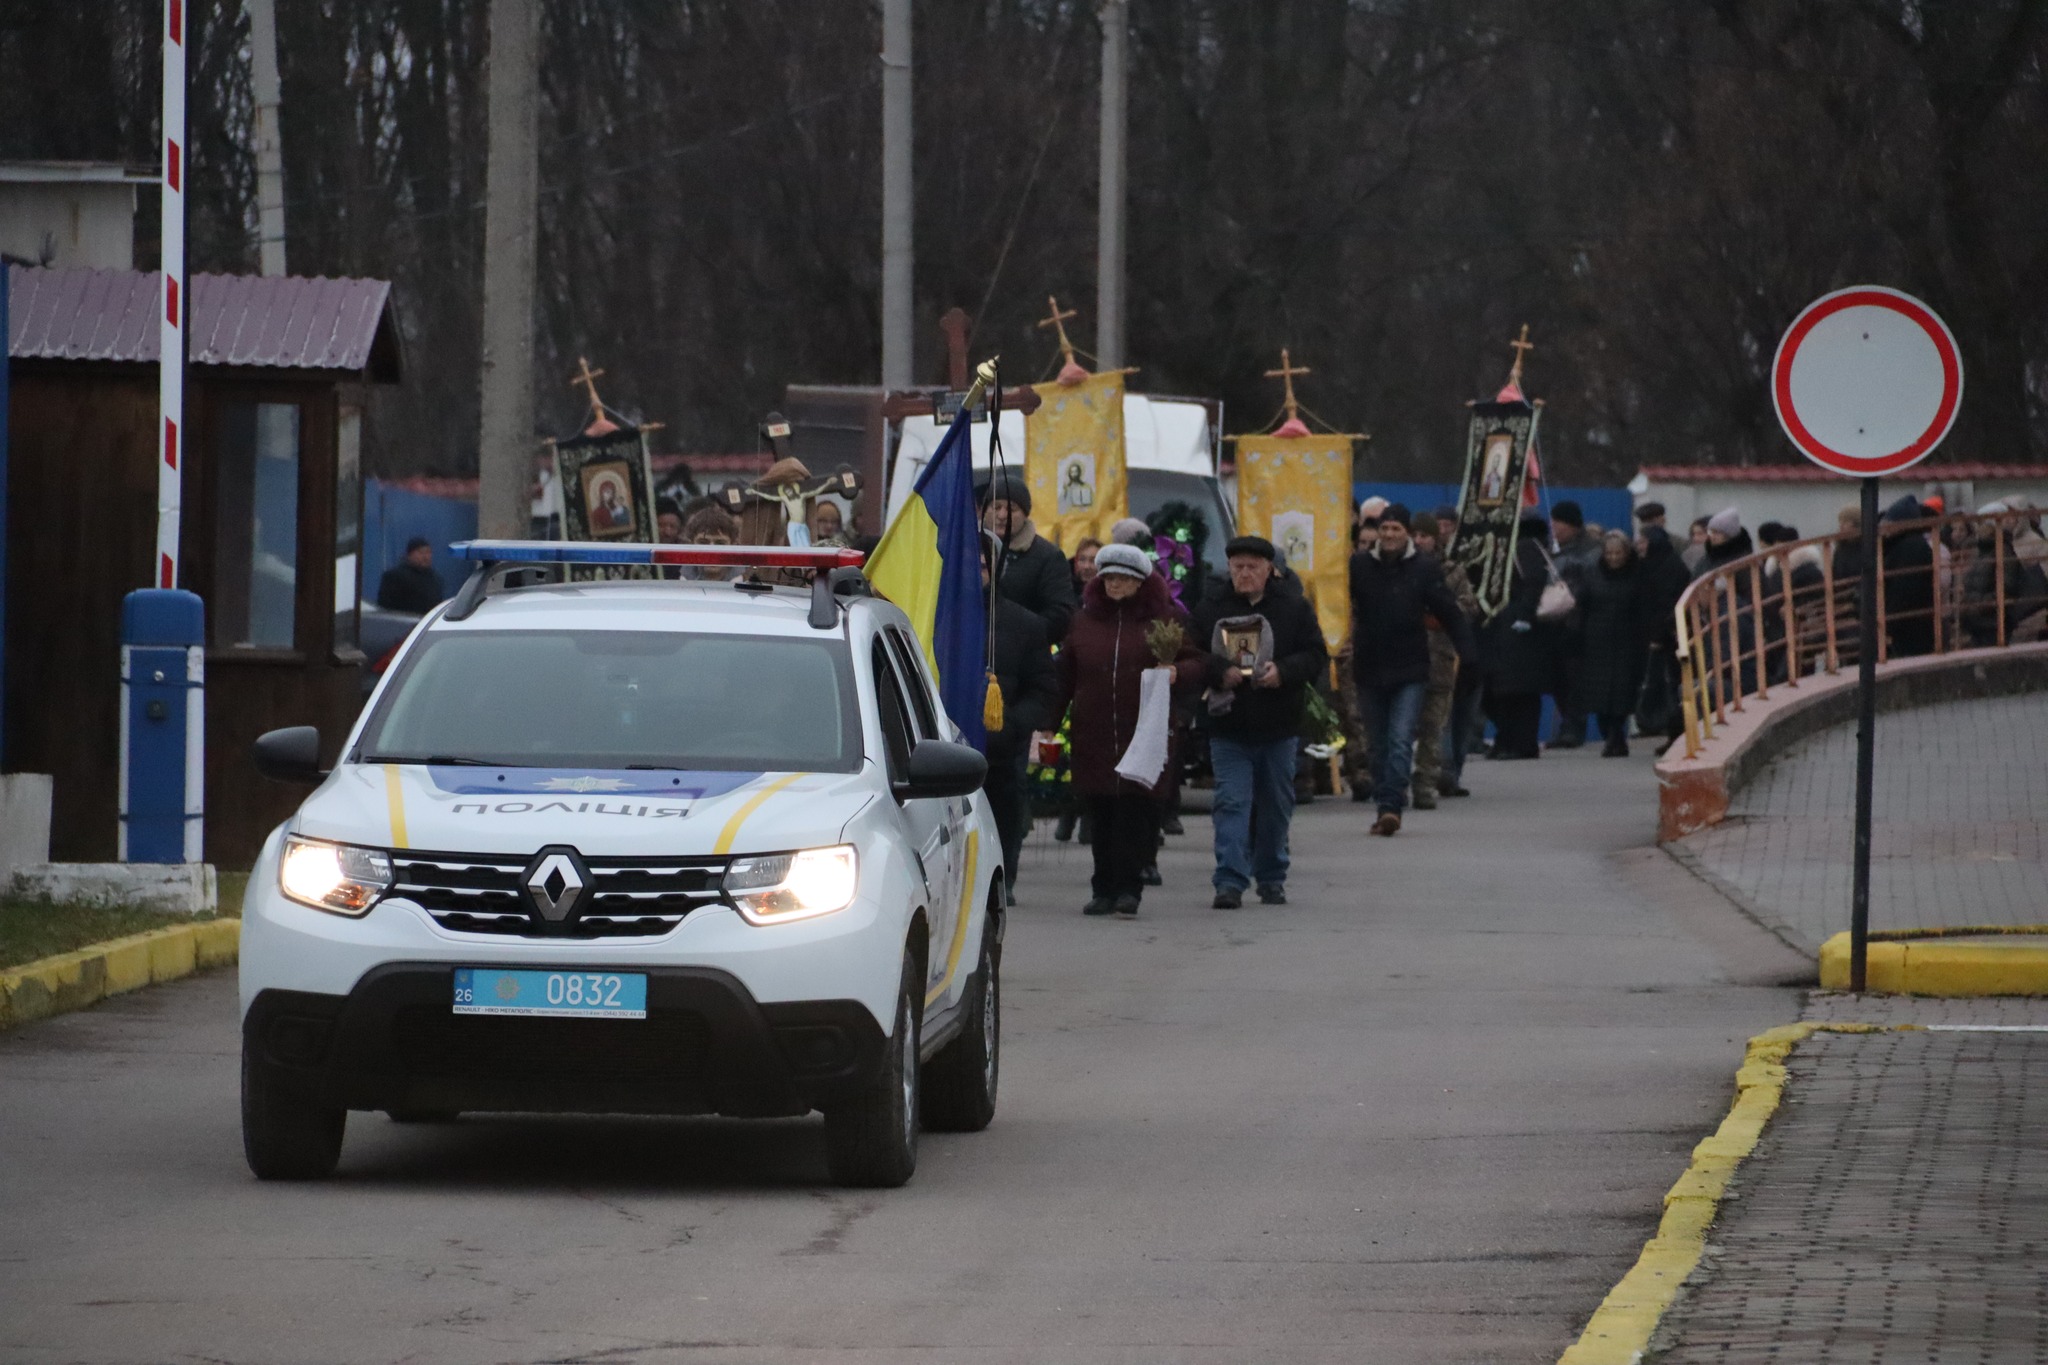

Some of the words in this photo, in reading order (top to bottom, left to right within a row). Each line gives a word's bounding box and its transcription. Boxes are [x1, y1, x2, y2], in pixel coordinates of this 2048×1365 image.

[452, 802, 690, 818] ПОЛІЦІЯ
[454, 988, 473, 1002] 26
[547, 974, 622, 1007] 0832
